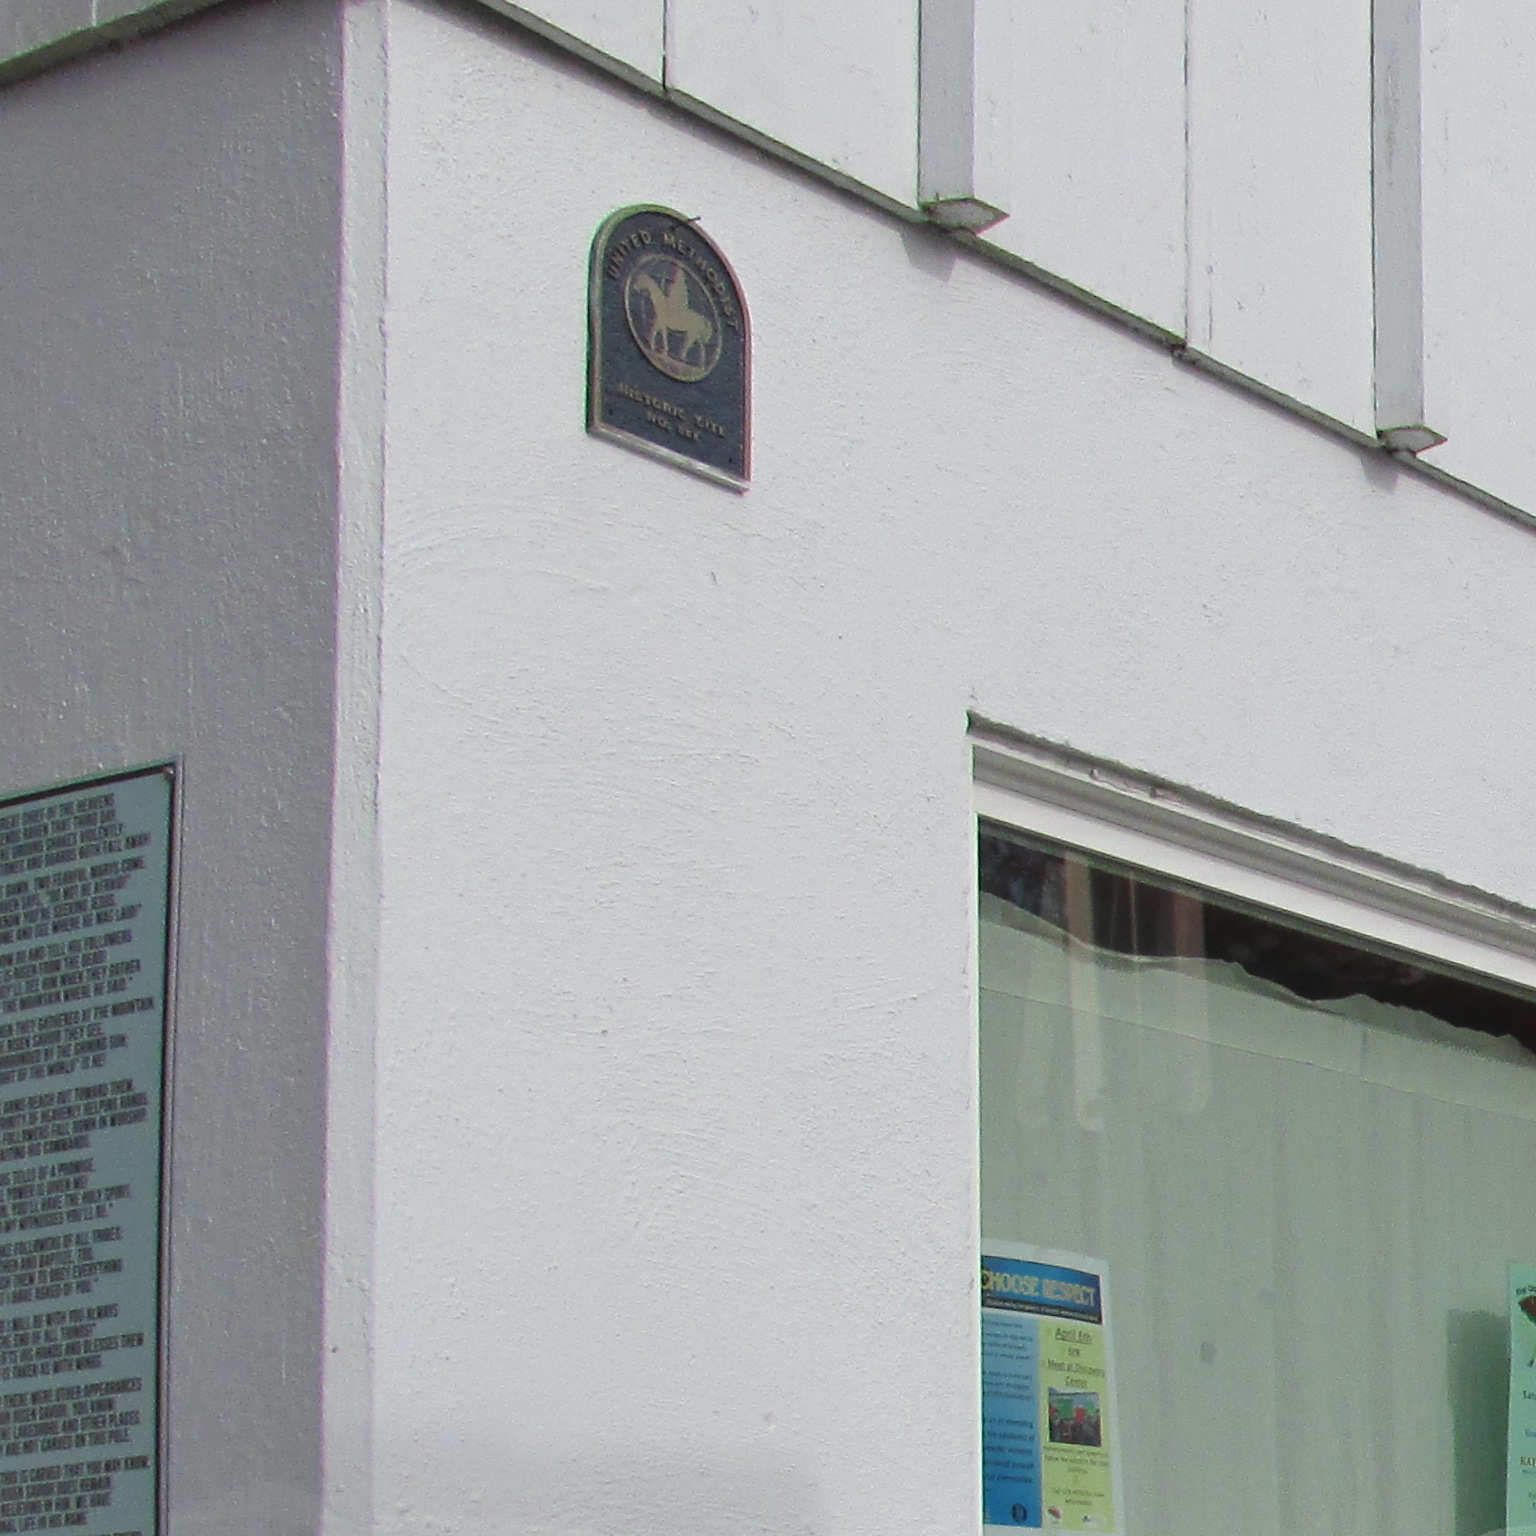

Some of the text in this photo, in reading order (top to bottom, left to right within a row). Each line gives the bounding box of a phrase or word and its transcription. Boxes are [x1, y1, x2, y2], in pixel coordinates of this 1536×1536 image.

[608, 231, 739, 331] UNITED METHODIST
[618, 382, 687, 421] HISTORIC
